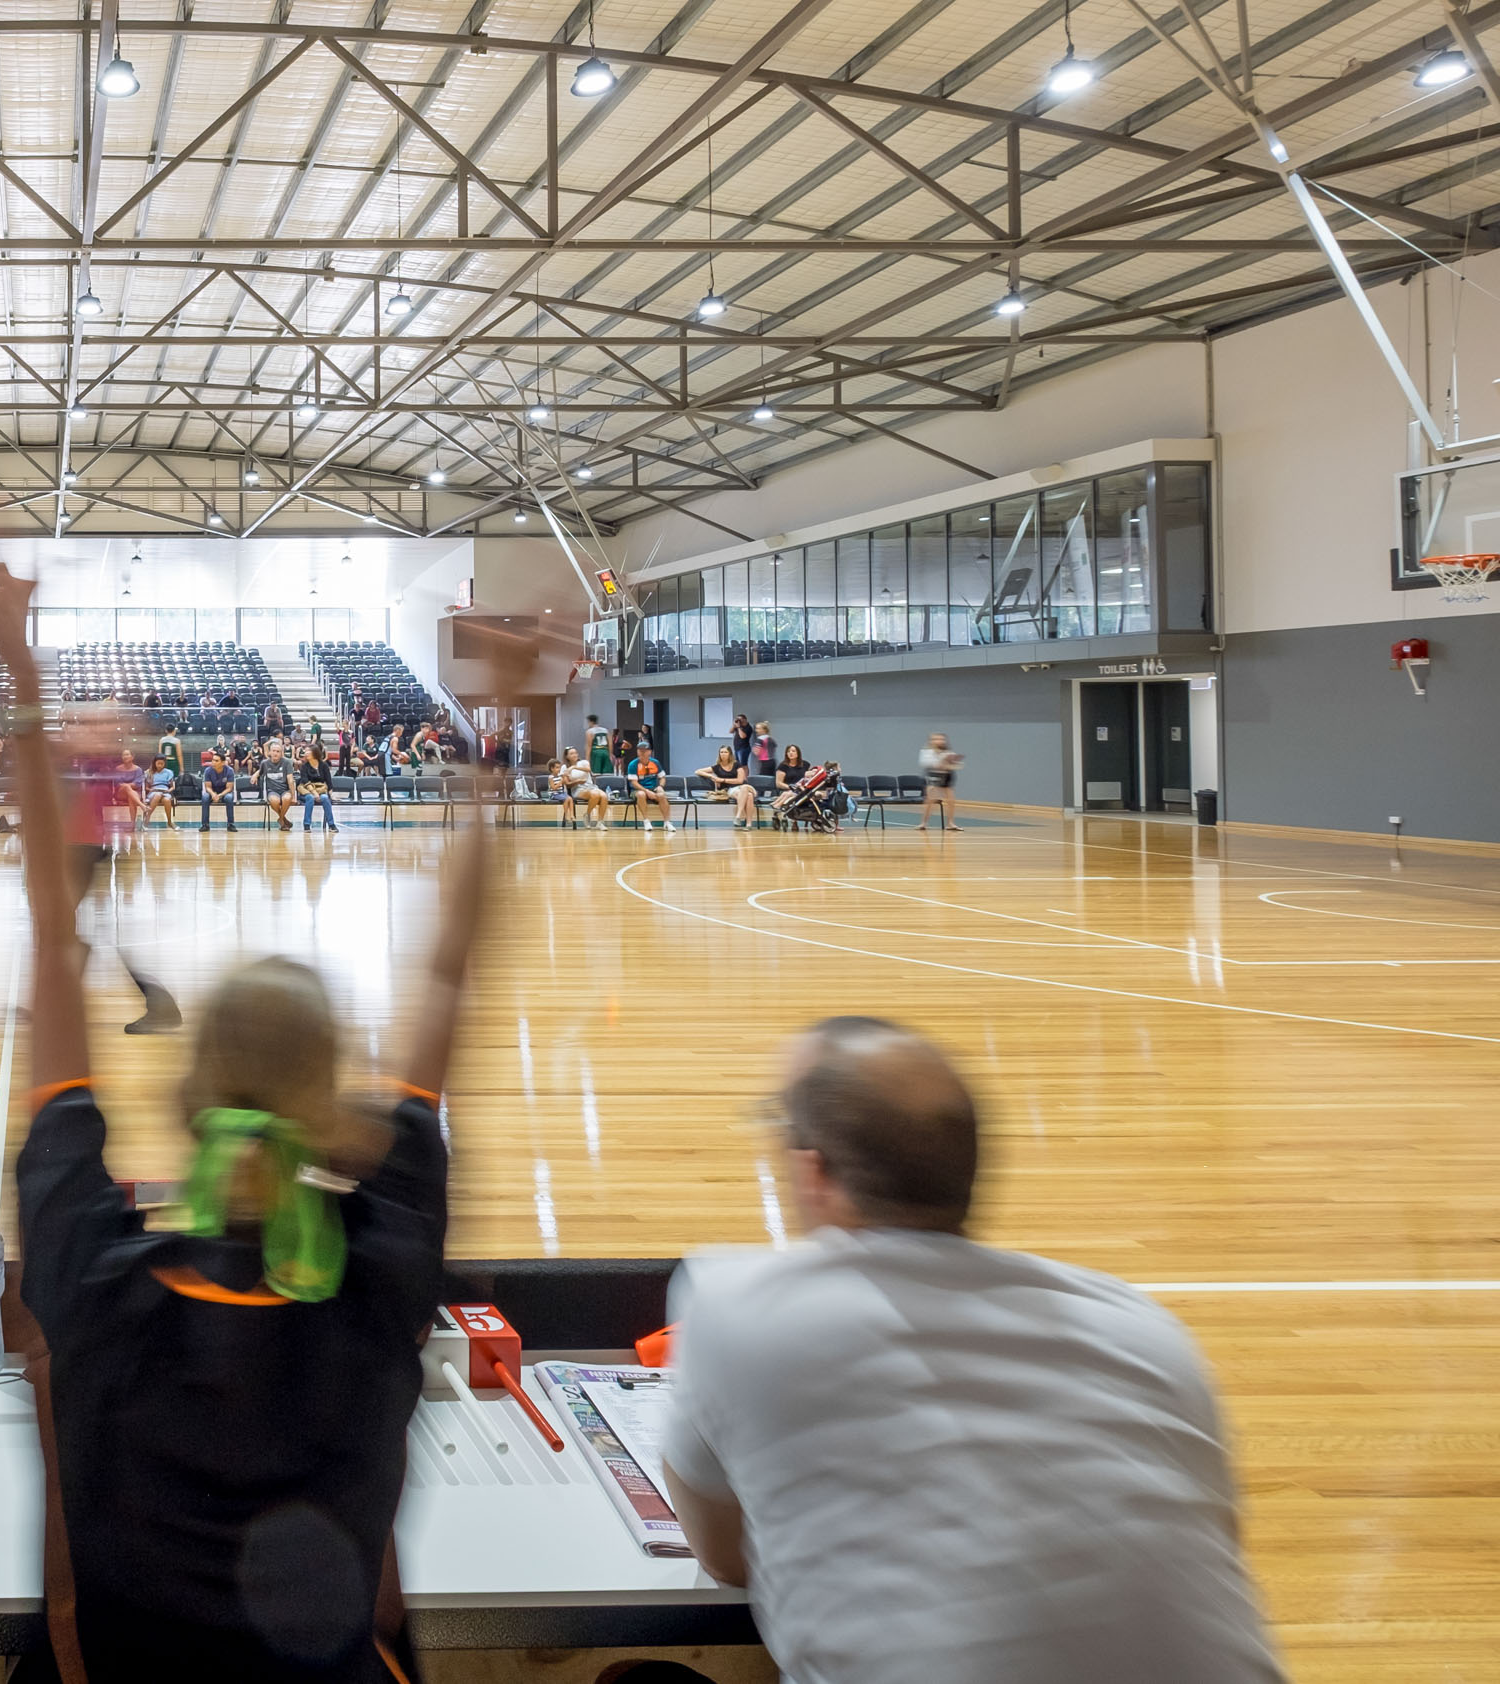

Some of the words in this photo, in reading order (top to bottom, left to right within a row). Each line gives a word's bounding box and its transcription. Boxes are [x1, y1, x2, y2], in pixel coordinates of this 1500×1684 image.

[1098, 663, 1138, 675] TOILETS
[850, 679, 857, 696] 1
[459, 1306, 505, 1332] 5
[588, 1370, 617, 1380] NEW
